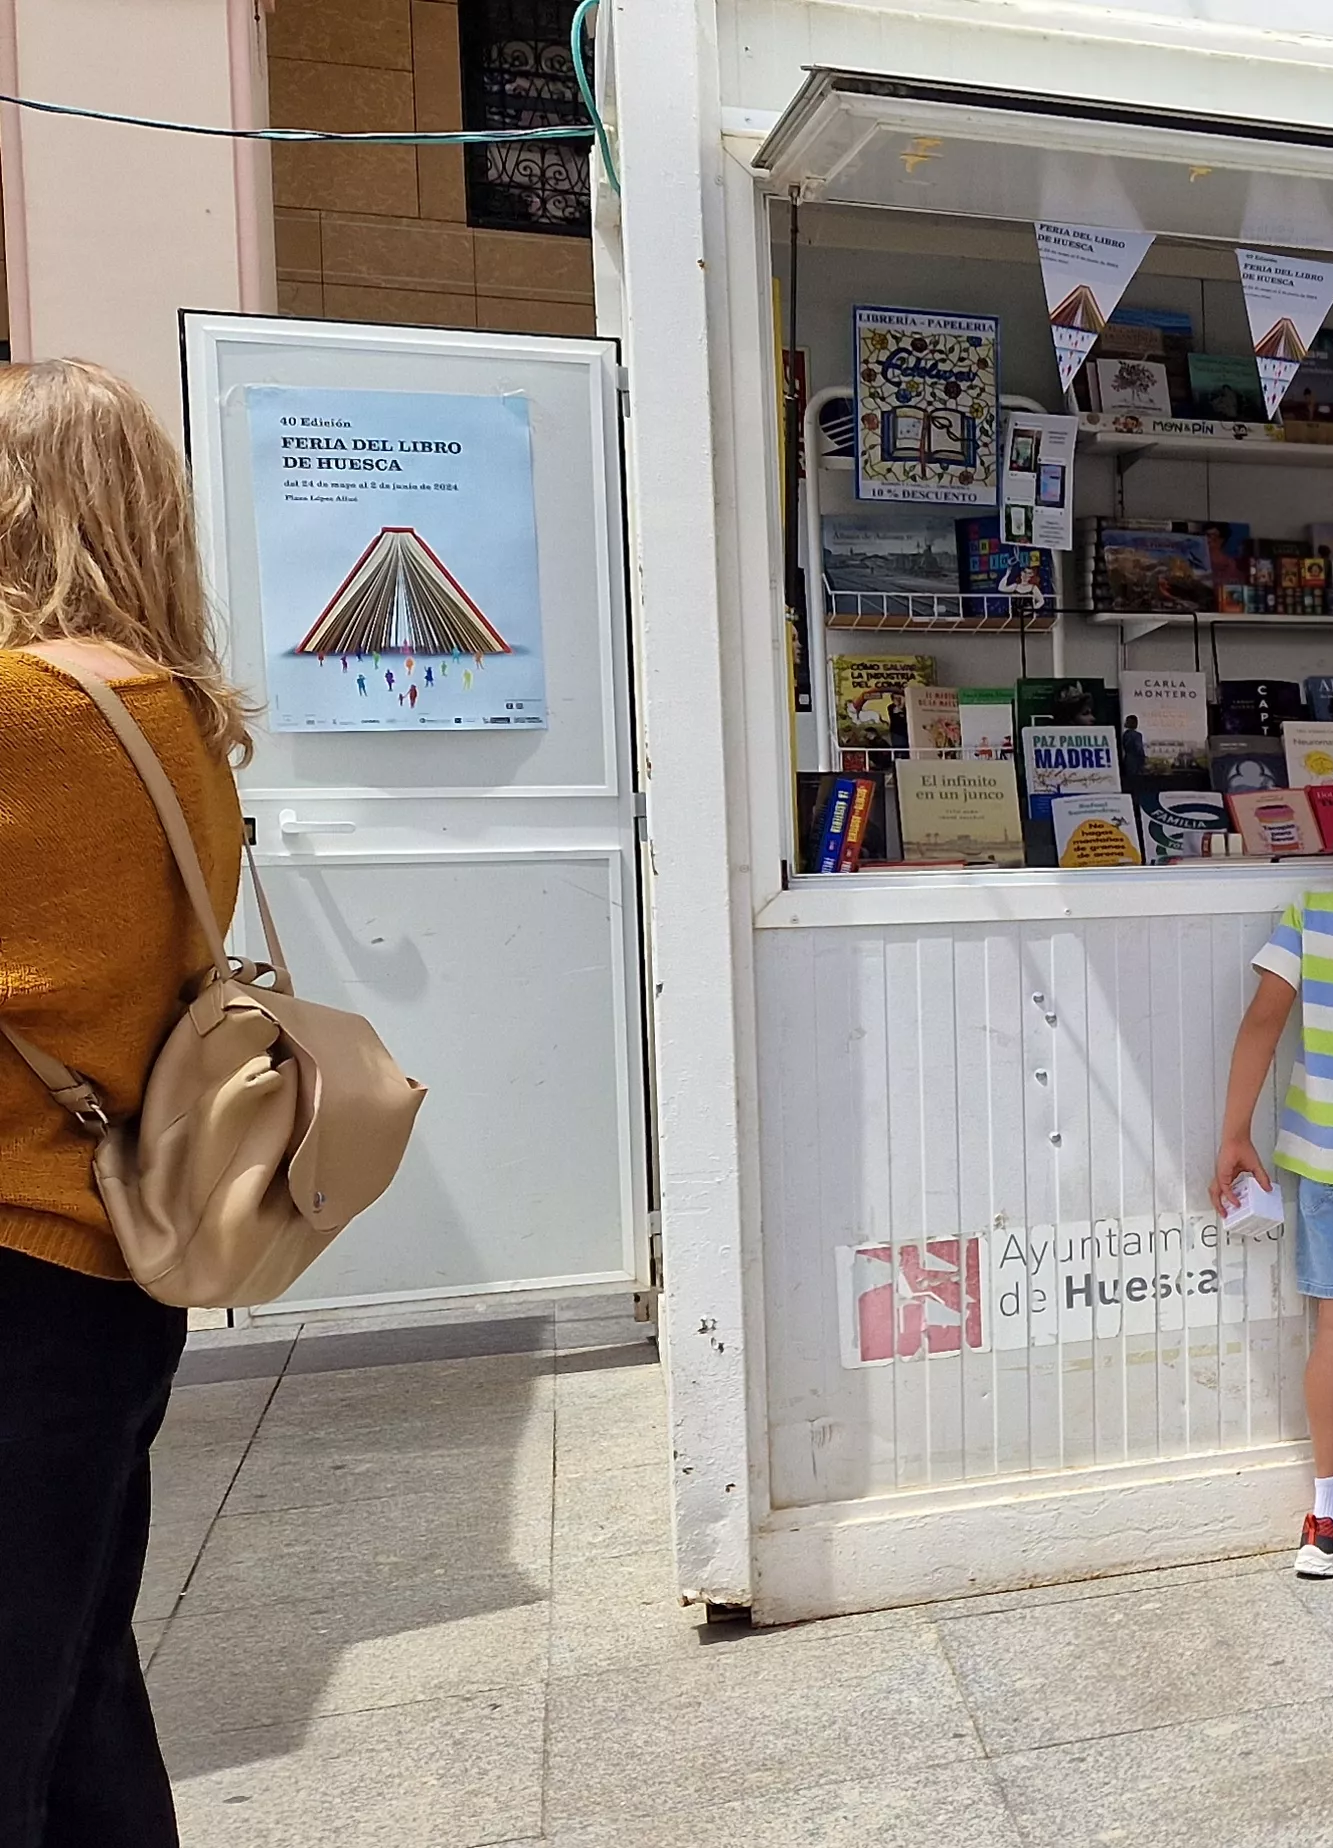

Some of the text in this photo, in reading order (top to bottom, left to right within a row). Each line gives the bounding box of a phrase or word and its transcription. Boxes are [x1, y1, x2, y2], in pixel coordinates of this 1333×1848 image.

[1039, 223, 1125, 248] FERIA DEL LIBRO
[1038, 234, 1094, 252] DE HUESCA
[1244, 263, 1324, 282] FERIA DEL LIBRO
[1257, 275, 1295, 287] HUESCA
[858, 313, 917, 326] LIBRERÍA
[280, 417, 352, 428] 40 Edición
[281, 436, 462, 455] FERIA DEL LIBRO
[283, 456, 403, 472] DE HUESCA
[871, 488, 977, 502] 10 % DESCUENTO
[866, 672, 916, 680] INDUSTRIA
[851, 681, 872, 689] DEL
[1144, 679, 1186, 688] CARLA
[1134, 689, 1197, 699] MONTERO
[1033, 735, 1109, 747] PAZ PADILLA
[1034, 748, 1111, 768] MADRE!
[921, 775, 997, 787] El infinito
[916, 788, 1004, 802] en un junco
[1151, 809, 1207, 829] FAMILIA
[998, 1222, 1284, 1277] Ayuntameo
[998, 1281, 1046, 1318] de
